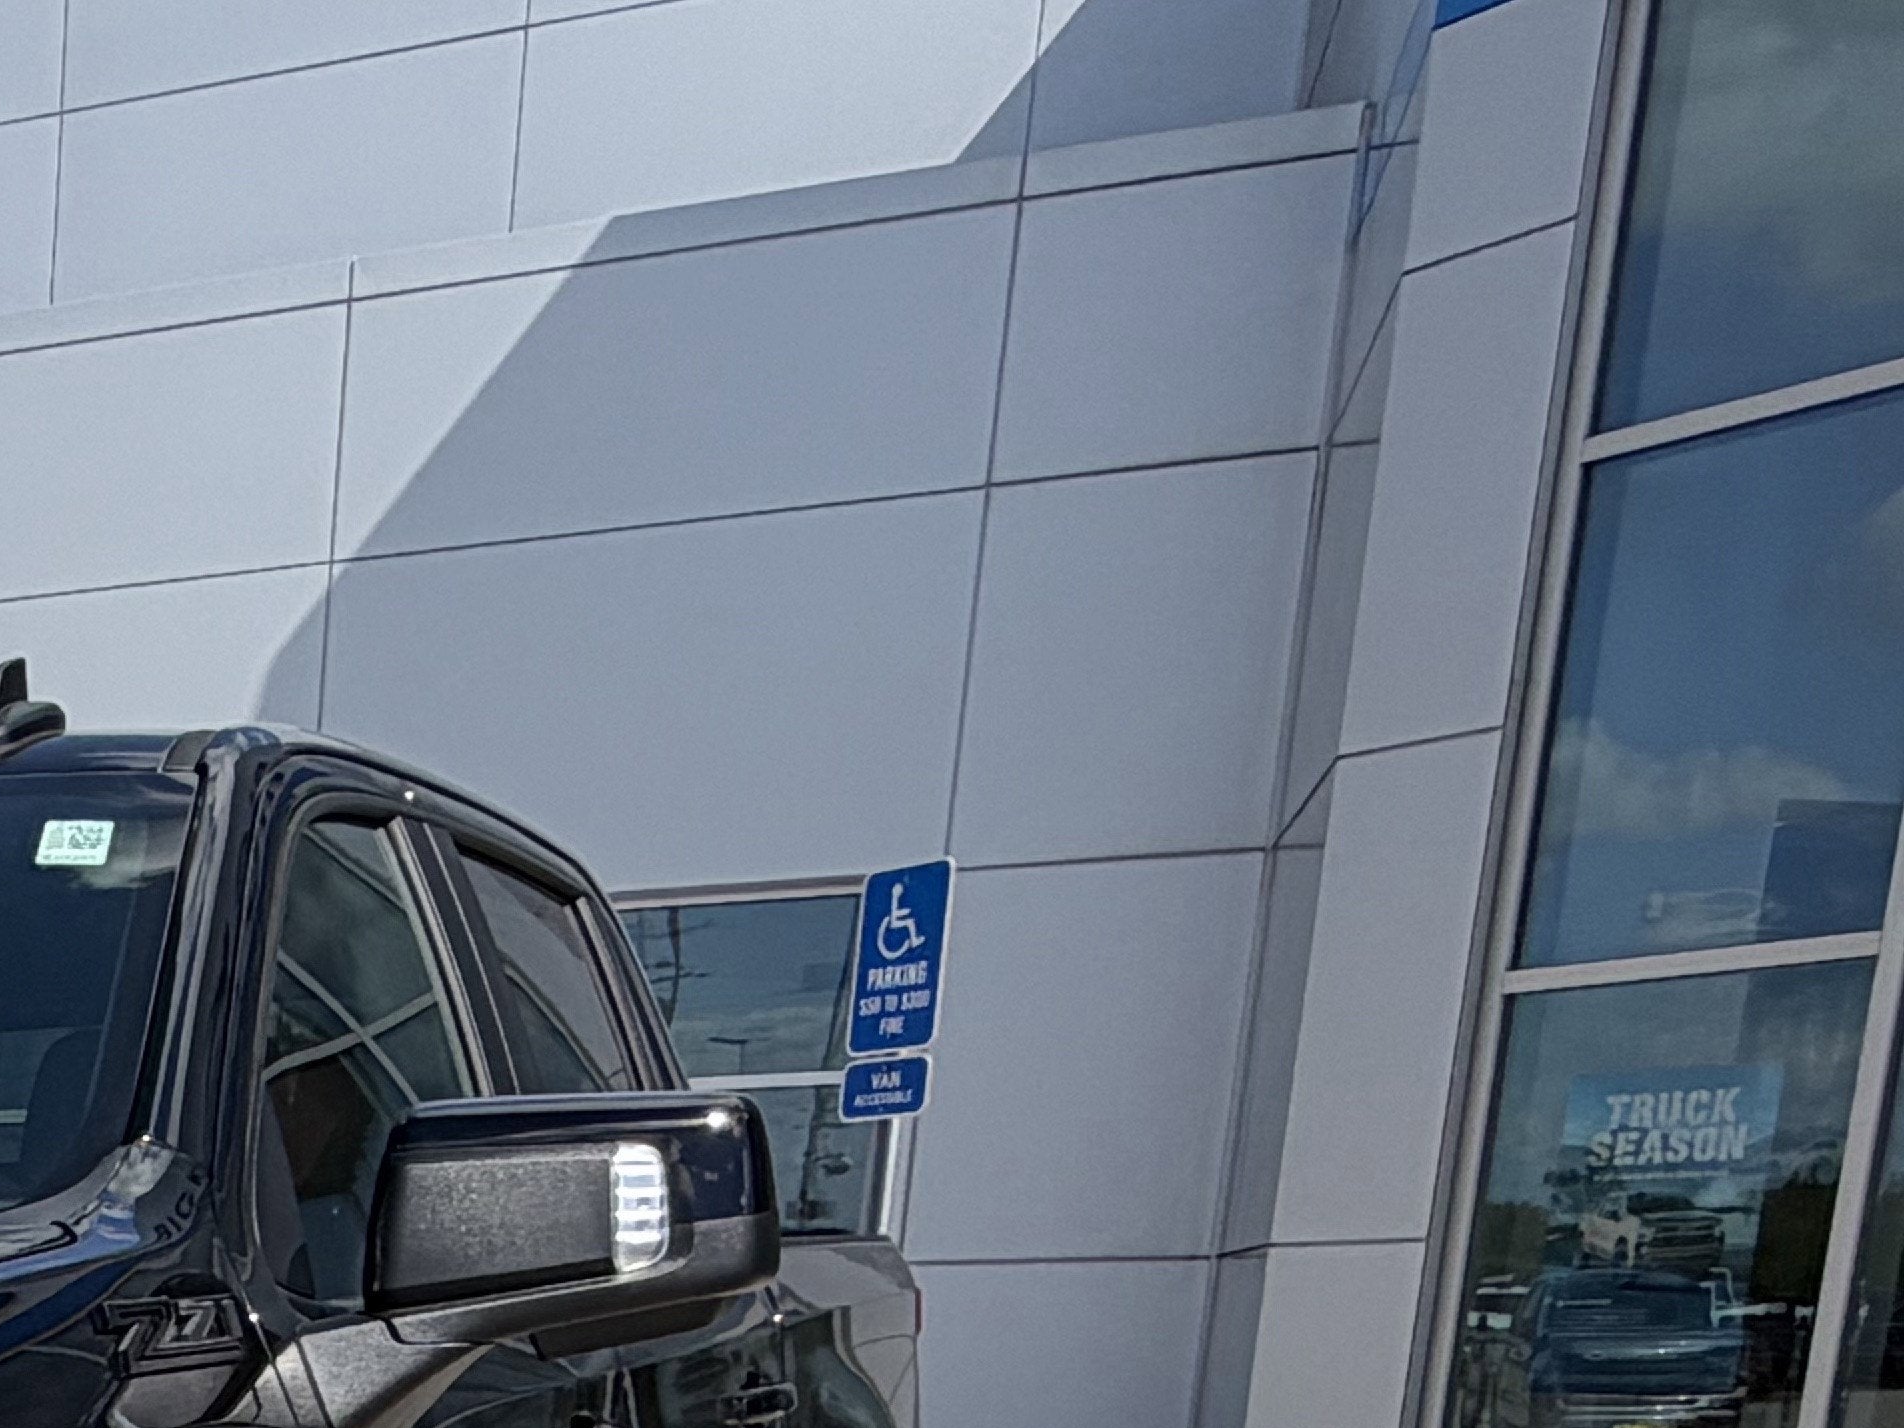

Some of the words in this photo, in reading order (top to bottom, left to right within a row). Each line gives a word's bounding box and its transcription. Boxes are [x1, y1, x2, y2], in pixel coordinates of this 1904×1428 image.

[867, 960, 928, 991] PARKING
[884, 994, 898, 1013] TO
[871, 1070, 902, 1090] VAN
[854, 1089, 913, 1107] ACCESSIBLE
[1606, 1087, 1742, 1130] TRUCK
[1587, 1122, 1749, 1166] SEASON
